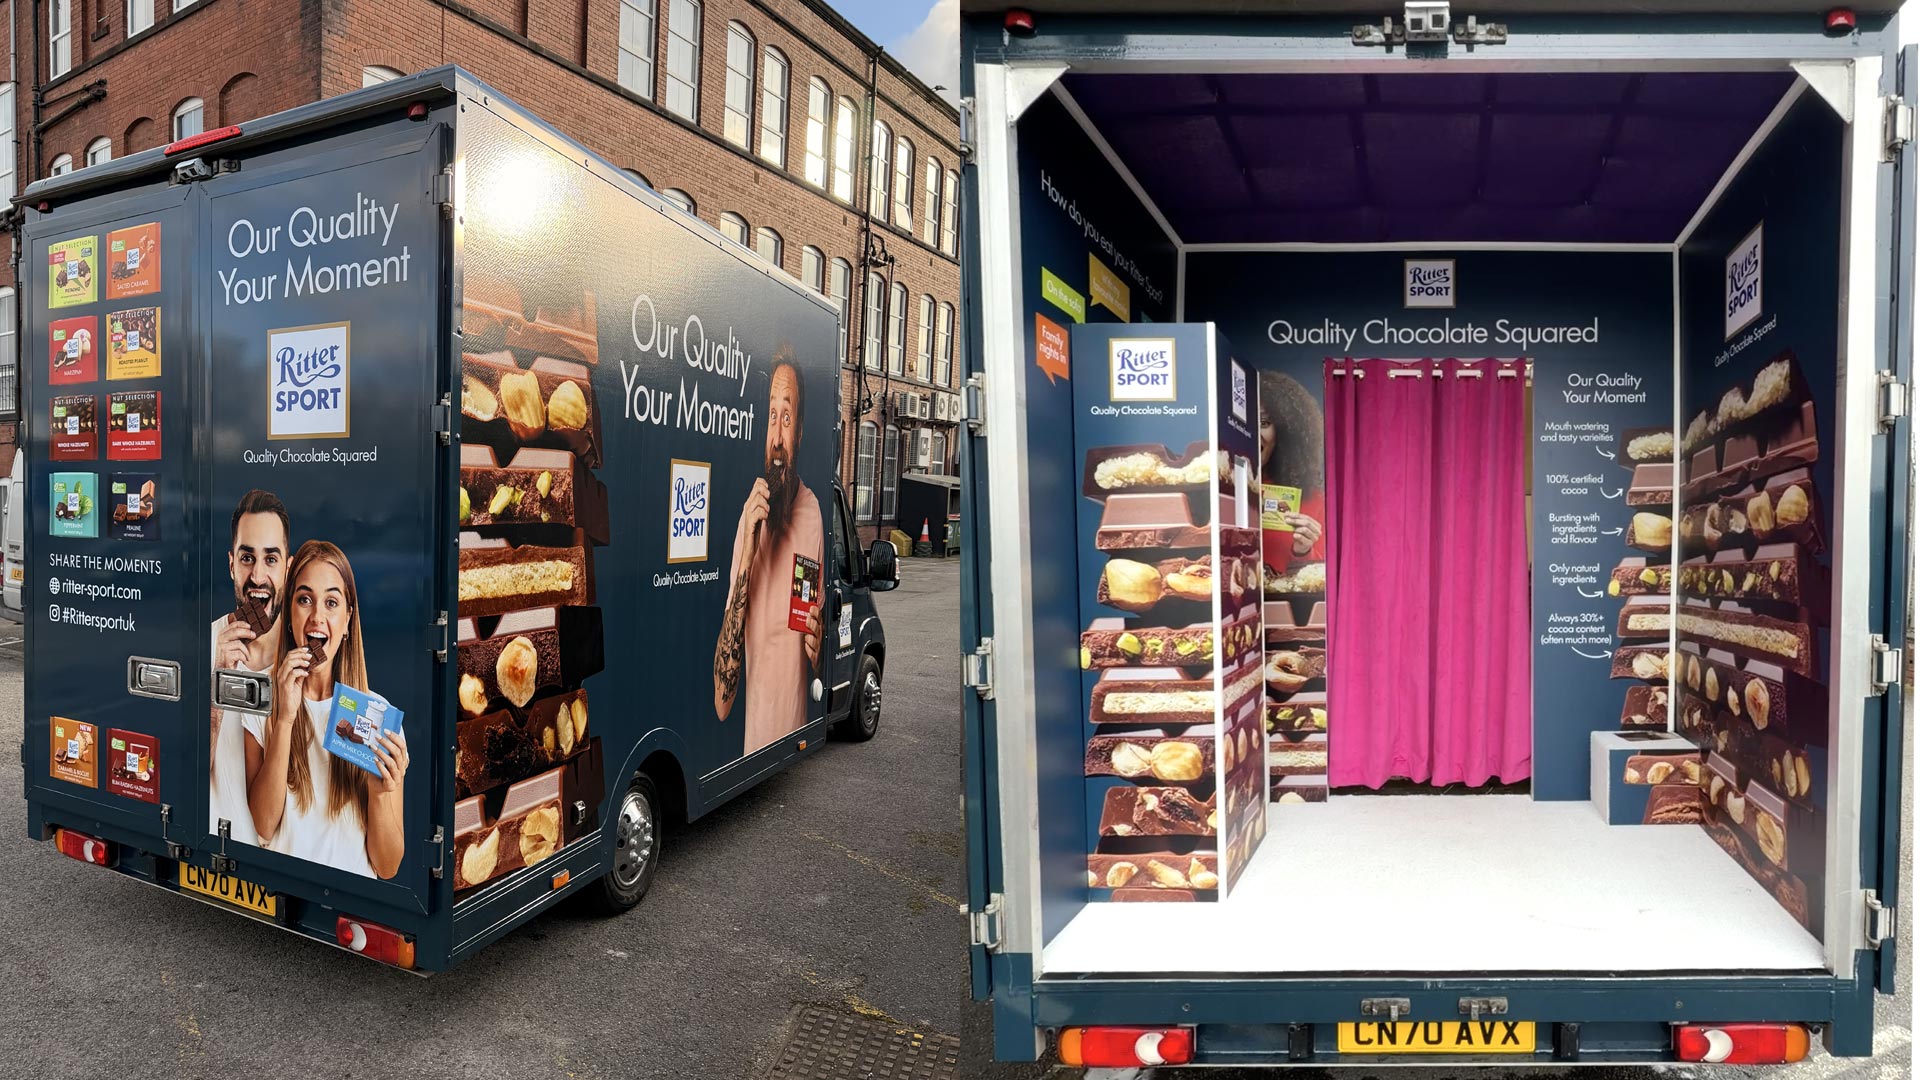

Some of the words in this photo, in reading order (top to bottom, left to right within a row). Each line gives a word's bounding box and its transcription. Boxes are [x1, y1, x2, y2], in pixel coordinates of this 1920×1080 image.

[228, 219, 281, 258] Our
[288, 192, 400, 247] Quality
[1041, 169, 1068, 211] How
[1068, 199, 1082, 226] do
[1083, 217, 1099, 243] you
[1099, 236, 1114, 256] eat
[1113, 248, 1130, 273] your
[218, 268, 277, 306] Your
[284, 246, 411, 298] Moment
[1409, 266, 1450, 286] Ritter
[1728, 244, 1759, 298] Ritter
[1046, 279, 1058, 298] On
[1409, 286, 1450, 297] SPORT
[1728, 277, 1759, 318] SPORT
[125, 309, 154, 319] SELECTION
[1042, 324, 1064, 351] Family
[1267, 317, 1357, 352] Quality
[1363, 317, 1488, 345] Chocolate
[1494, 317, 1599, 351] Squared
[632, 293, 679, 360] Our
[683, 314, 751, 398] Quality
[1039, 341, 1060, 361] nights
[1059, 351, 1067, 365] in
[276, 344, 341, 387] Ritter
[1117, 348, 1169, 372] Ritter
[1117, 373, 1169, 386] SPORT
[1567, 373, 1593, 387] Our
[1595, 372, 1642, 390] Quality
[65, 397, 93, 405] SELECTION
[125, 393, 155, 401] SELECTION
[275, 387, 341, 412] SPORT
[620, 359, 673, 426] Your
[676, 375, 755, 441] Moment
[1562, 390, 1591, 404] Your
[1593, 390, 1647, 403] Moment
[1090, 405, 1120, 418] Quality
[1121, 405, 1162, 415] Chocolate
[1162, 405, 1198, 417] Squared
[1544, 421, 1572, 431] Mouth
[1573, 421, 1610, 433] watering
[1540, 432, 1557, 442] and
[1558, 433, 1578, 444] tasty
[243, 448, 278, 467] Quality
[279, 447, 330, 463] Chocolate
[331, 445, 377, 466] Squared
[1546, 474, 1569, 484] 100%
[1570, 473, 1604, 484] certified
[674, 477, 706, 516] Ritter
[1561, 487, 1588, 495] cocoa
[672, 517, 705, 538] SPORT
[1549, 512, 1581, 525] Bursting
[1582, 512, 1600, 522] with
[1551, 534, 1568, 544] and
[1569, 534, 1598, 544] flavour
[1552, 524, 1597, 535] ingredients
[50, 553, 81, 568] SHARE
[83, 555, 102, 570] THE
[104, 557, 162, 575] MOMENTS
[1548, 563, 1571, 575] Only
[1571, 563, 1600, 573] natural
[652, 571, 673, 590] Quality
[673, 569, 699, 585] Chocolate
[699, 567, 719, 585] Squared
[1552, 575, 1597, 586] ingredients
[62, 578, 142, 601] ritter-sport.com
[62, 606, 136, 633] #Rittersportuk
[1548, 612, 1579, 624] Always
[1579, 613, 1604, 623] 30%+
[1540, 634, 1564, 645] (often
[1564, 634, 1588, 644] much
[1588, 634, 1612, 645] more)
[1548, 625, 1574, 634] cocoa
[1575, 625, 1605, 634] content
[79, 723, 92, 732] NEW
[186, 864, 229, 896] CN70
[234, 879, 268, 910] AVX
[1455, 1021, 1520, 1046] AVX
